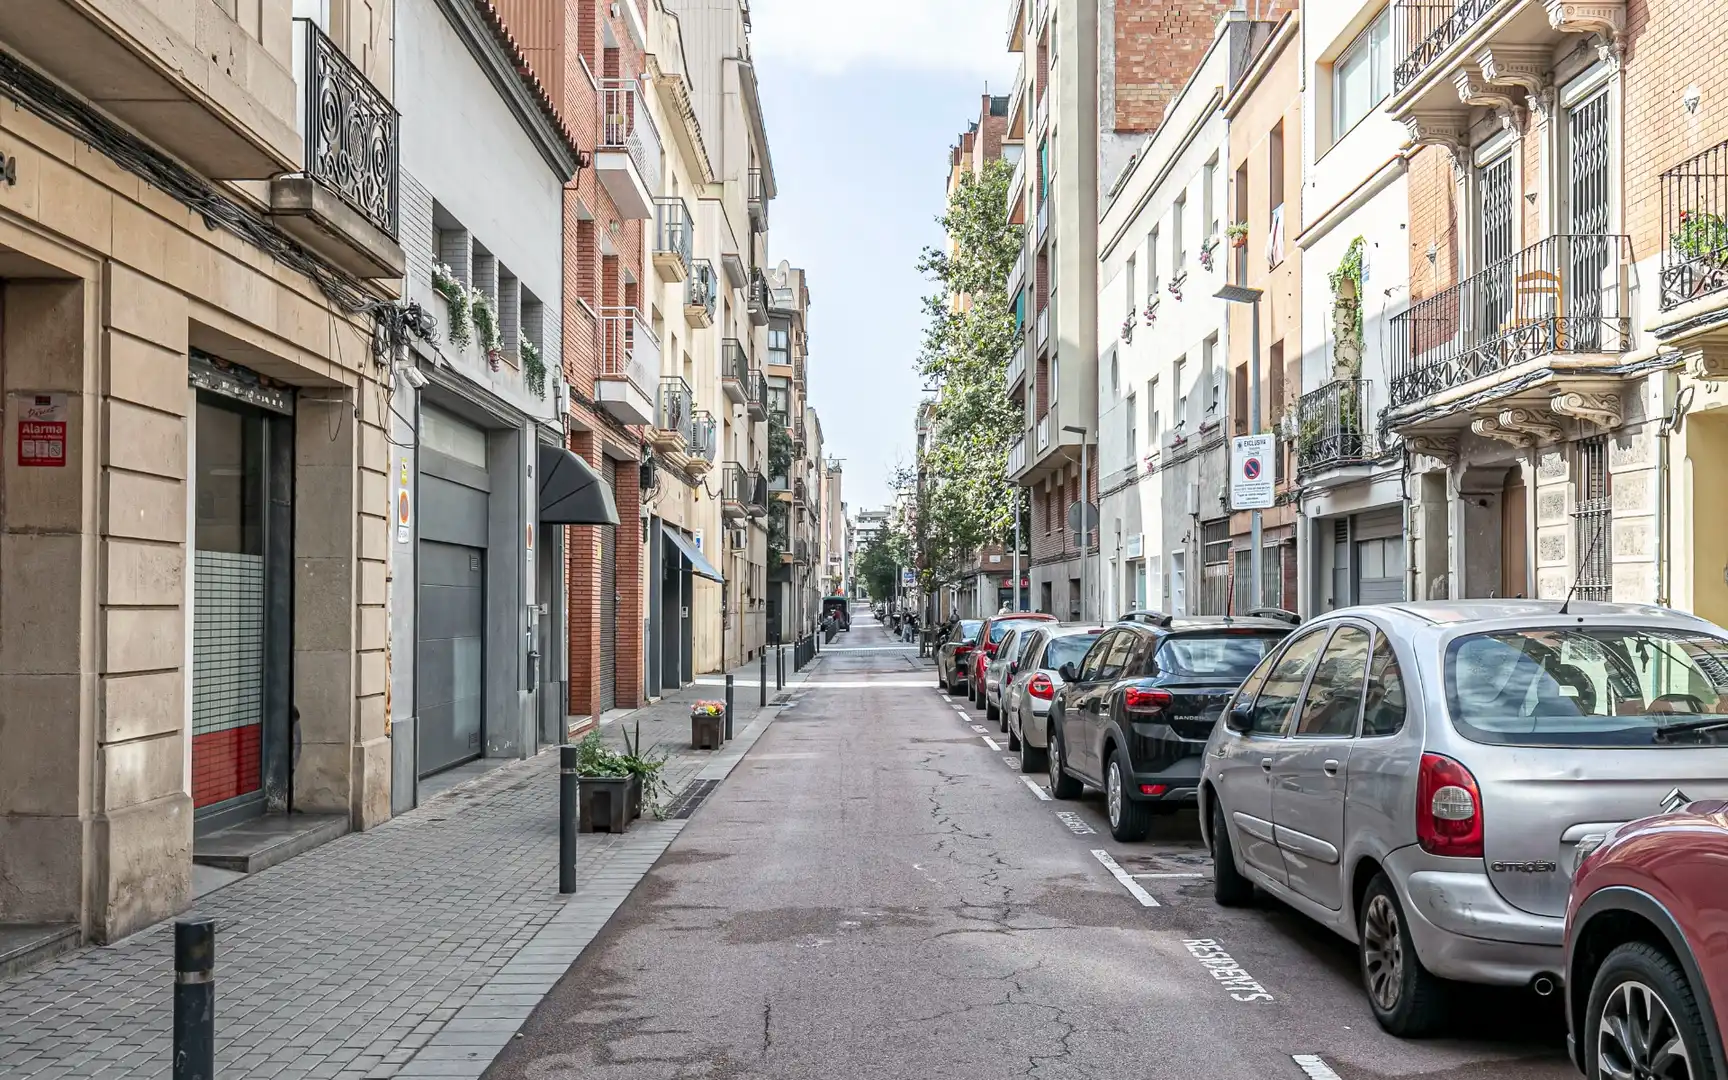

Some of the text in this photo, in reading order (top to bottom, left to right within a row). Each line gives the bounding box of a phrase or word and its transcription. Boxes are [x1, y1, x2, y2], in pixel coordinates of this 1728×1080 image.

[22, 423, 63, 434] Alarma
[1243, 439, 1266, 447] EXCLUSIVA
[1491, 860, 1556, 873] CITROËN
[1182, 938, 1274, 1002] RESIDENTS
